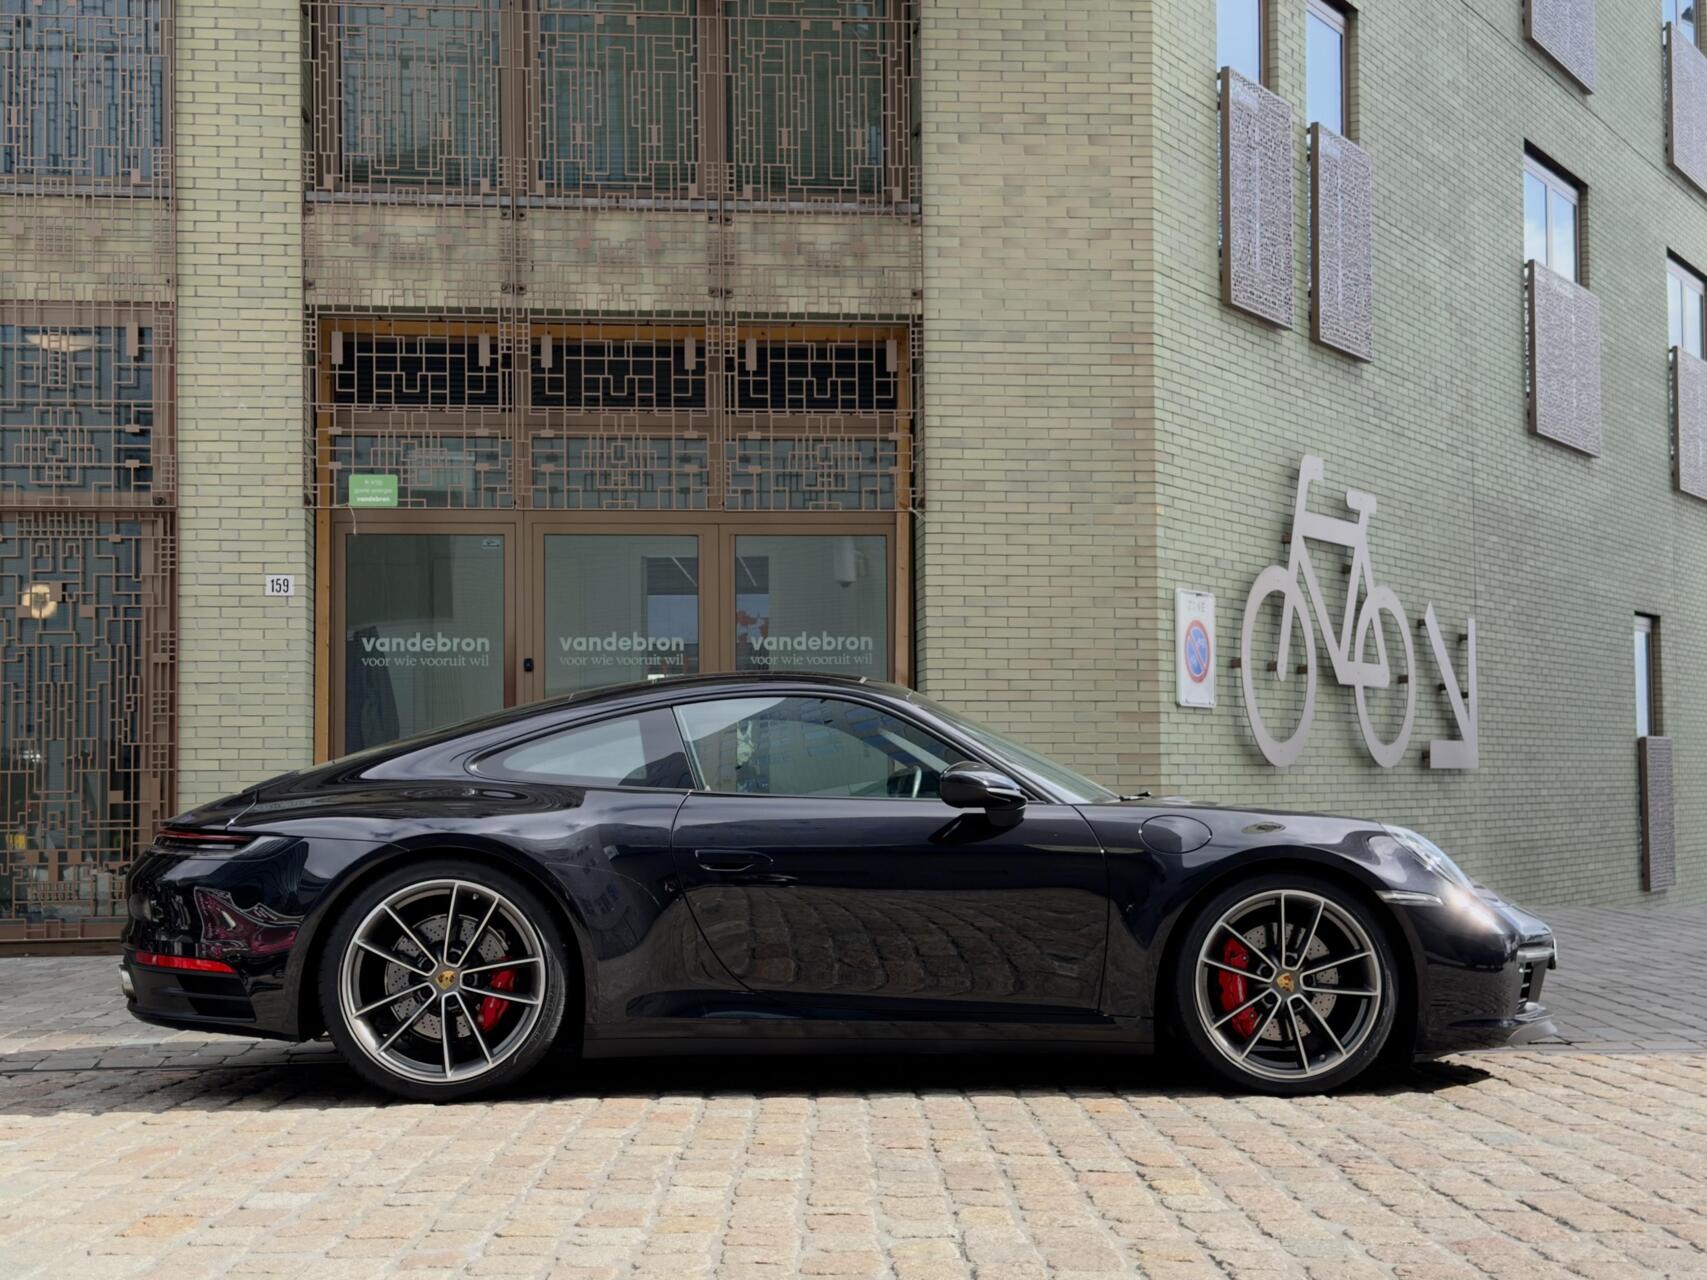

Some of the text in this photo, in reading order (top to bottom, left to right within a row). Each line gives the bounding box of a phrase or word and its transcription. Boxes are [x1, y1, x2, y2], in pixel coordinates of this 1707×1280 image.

[270, 578, 289, 593] 159
[361, 631, 490, 652] vandebron
[559, 631, 685, 652] vandebron
[750, 630, 873, 651] vandebron
[361, 654, 489, 667] voor wie vooruit wil
[559, 653, 685, 666] voor wie vooruit wil
[750, 653, 873, 665] voor wie vooruit wil
